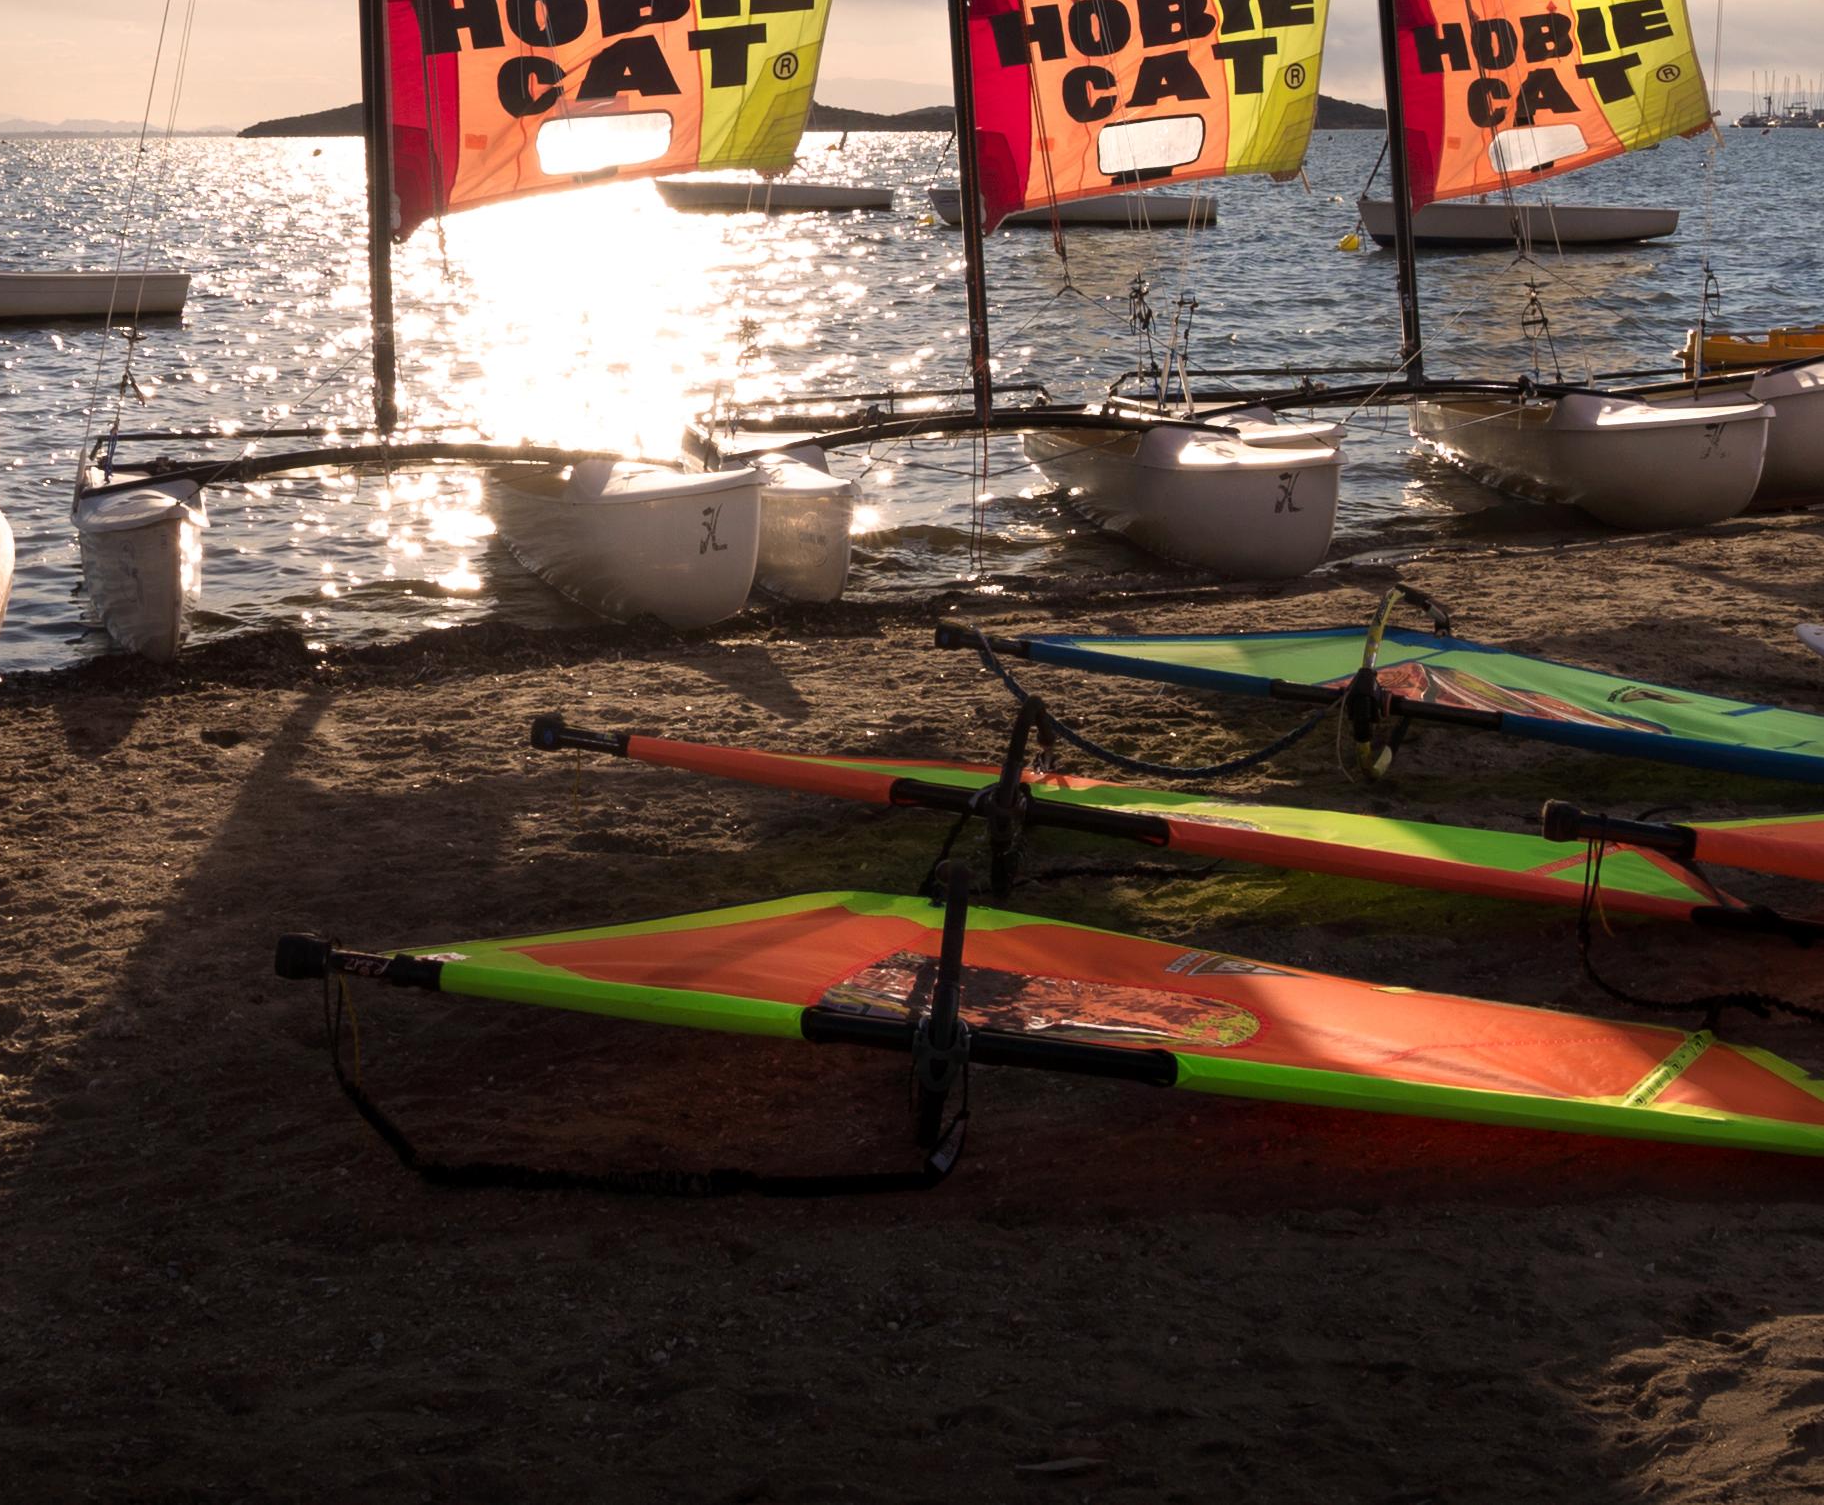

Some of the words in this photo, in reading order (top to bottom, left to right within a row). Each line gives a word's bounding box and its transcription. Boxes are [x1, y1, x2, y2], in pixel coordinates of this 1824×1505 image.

[496, 22, 767, 118] CAT
[1061, 36, 1278, 123] CAT
[1466, 51, 1642, 129] CAT
